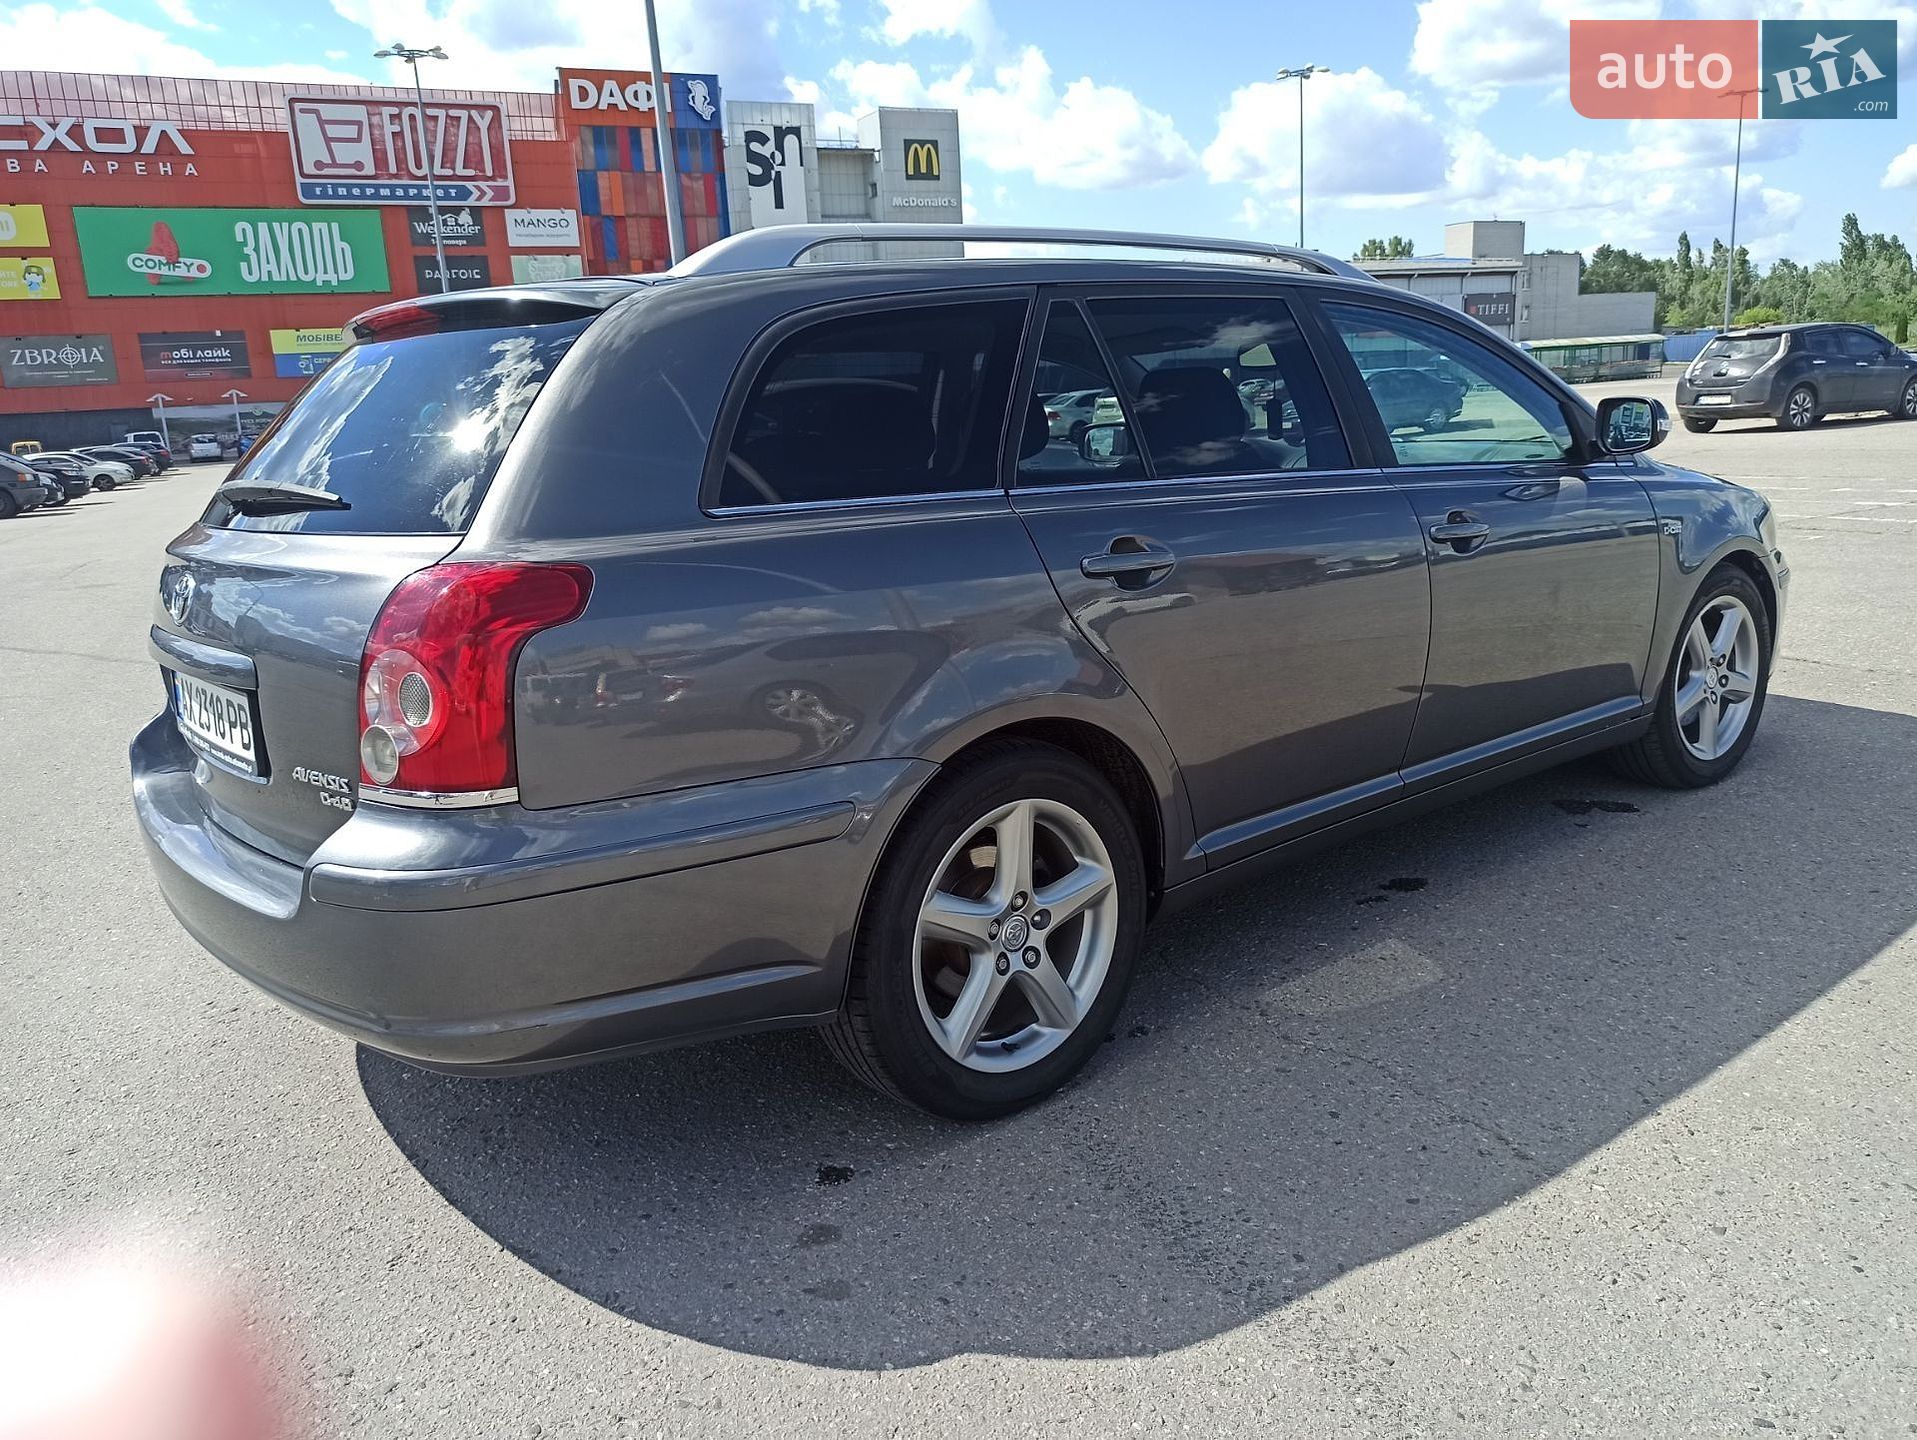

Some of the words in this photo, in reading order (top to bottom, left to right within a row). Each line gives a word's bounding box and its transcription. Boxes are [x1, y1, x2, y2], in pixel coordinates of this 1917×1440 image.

[382, 106, 494, 177] FOZZY
[82, 160, 199, 176] АРЕНА
[892, 196, 958, 208] McDonald's
[413, 222, 482, 235] Wekender
[514, 218, 570, 229] MANGO
[234, 221, 355, 287] ЗАХОДЬ
[131, 256, 194, 273] COMFY
[1477, 303, 1509, 316] TIFFI
[10, 344, 105, 368] ZBROIA
[196, 685, 226, 741] 2318
[225, 698, 252, 752] PB
[292, 766, 351, 794] AVENSIS
[319, 791, 354, 812] D-4D
